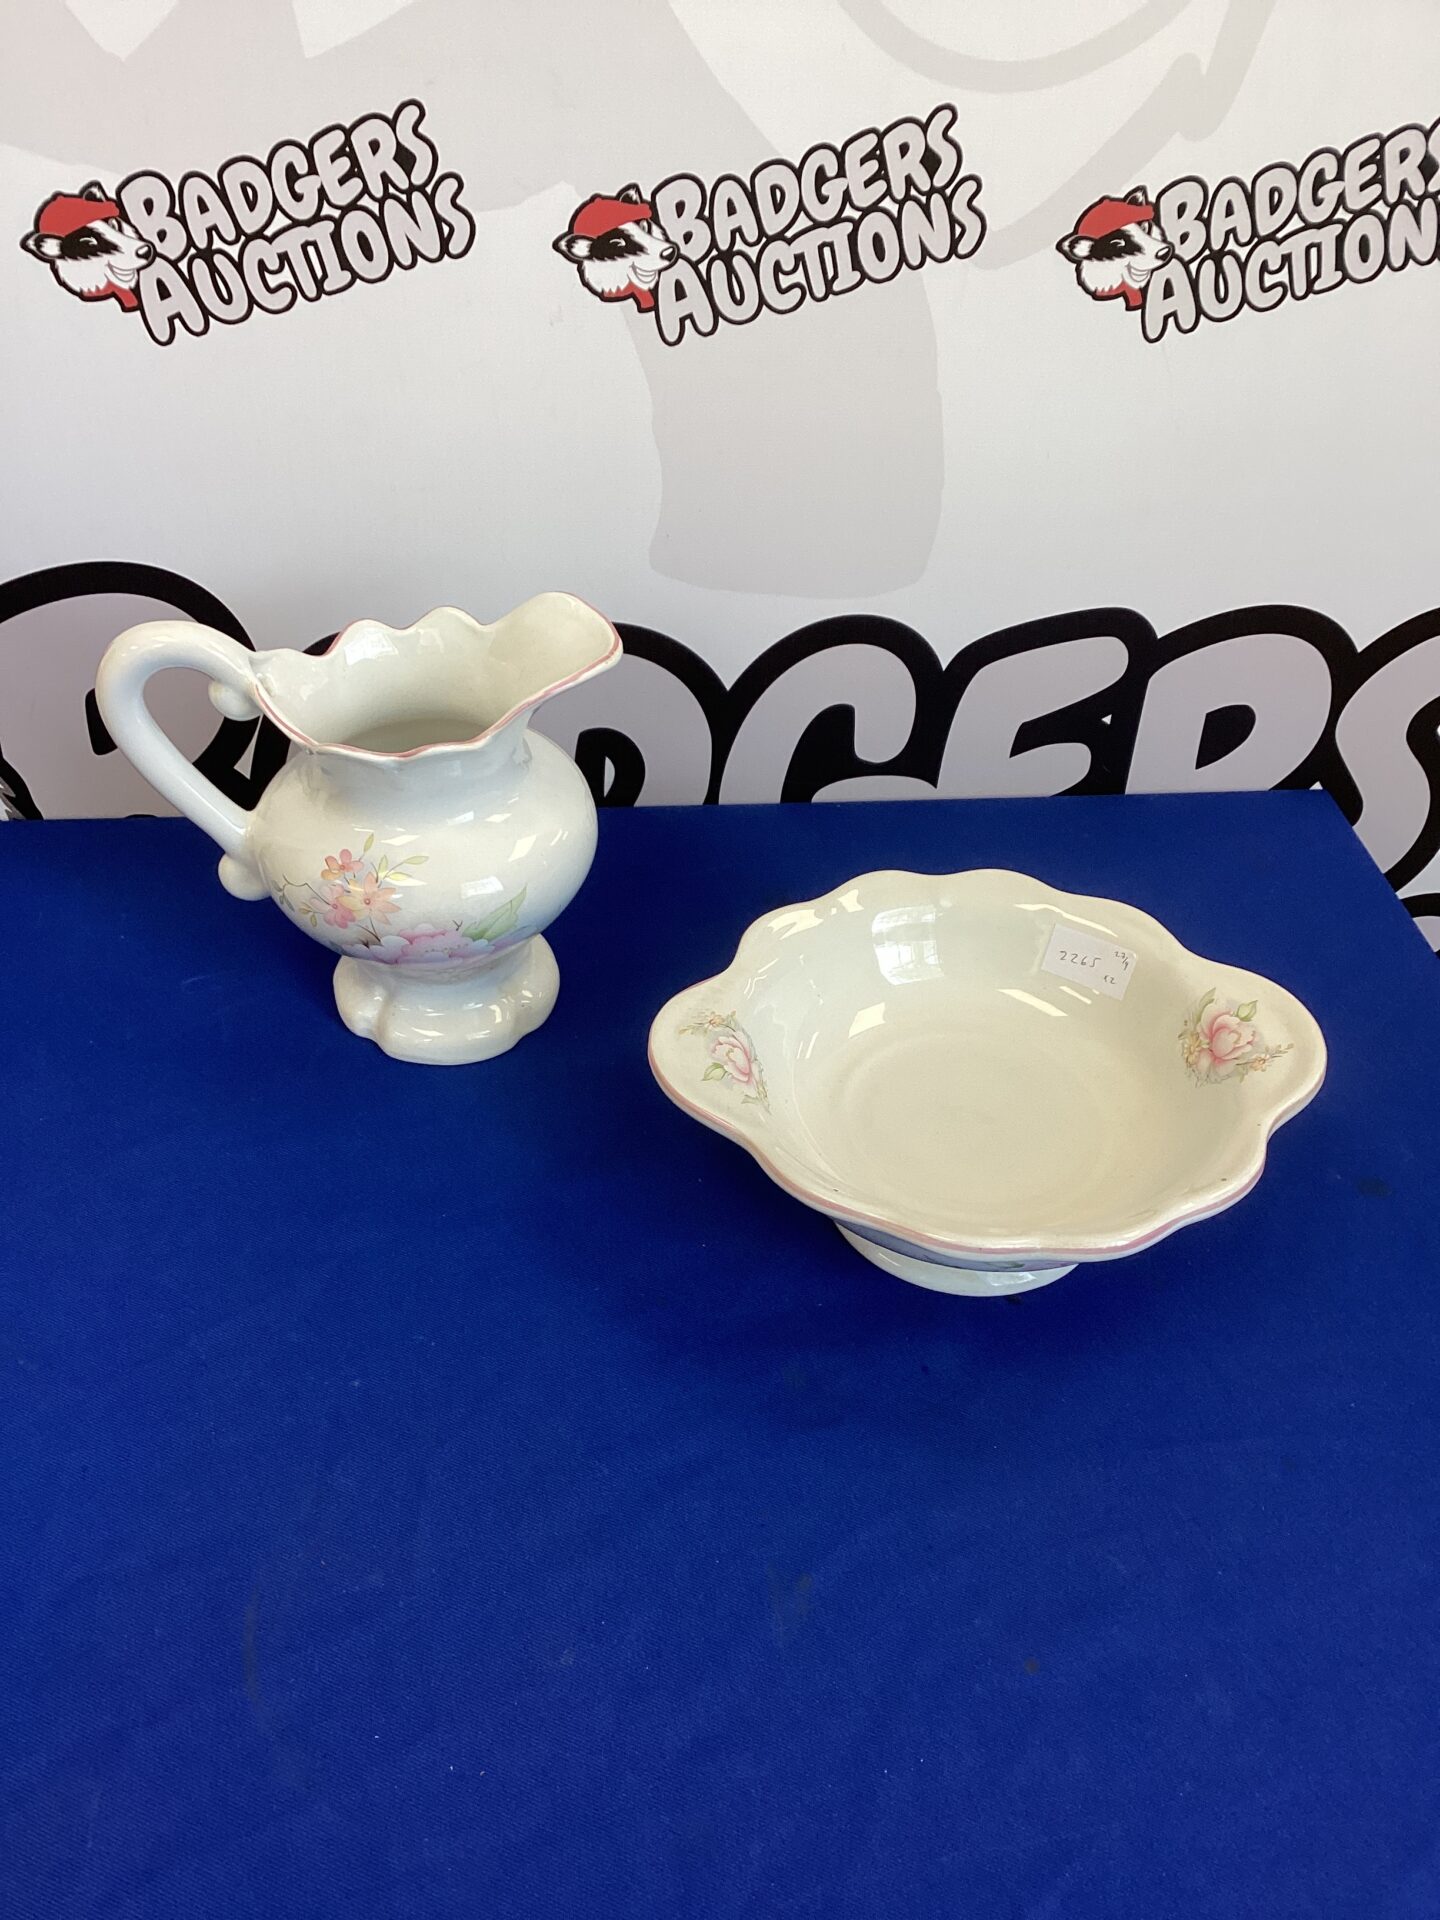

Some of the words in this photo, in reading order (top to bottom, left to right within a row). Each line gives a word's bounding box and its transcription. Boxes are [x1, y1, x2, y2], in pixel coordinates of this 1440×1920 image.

[116, 98, 440, 262] BADGERS
[138, 171, 476, 346] AUCTIONS
[652, 102, 963, 262] BADGERS
[654, 174, 987, 346] AUCTIONS
[1141, 197, 1440, 343] AUCTION
[1059, 950, 1102, 968] 2265
